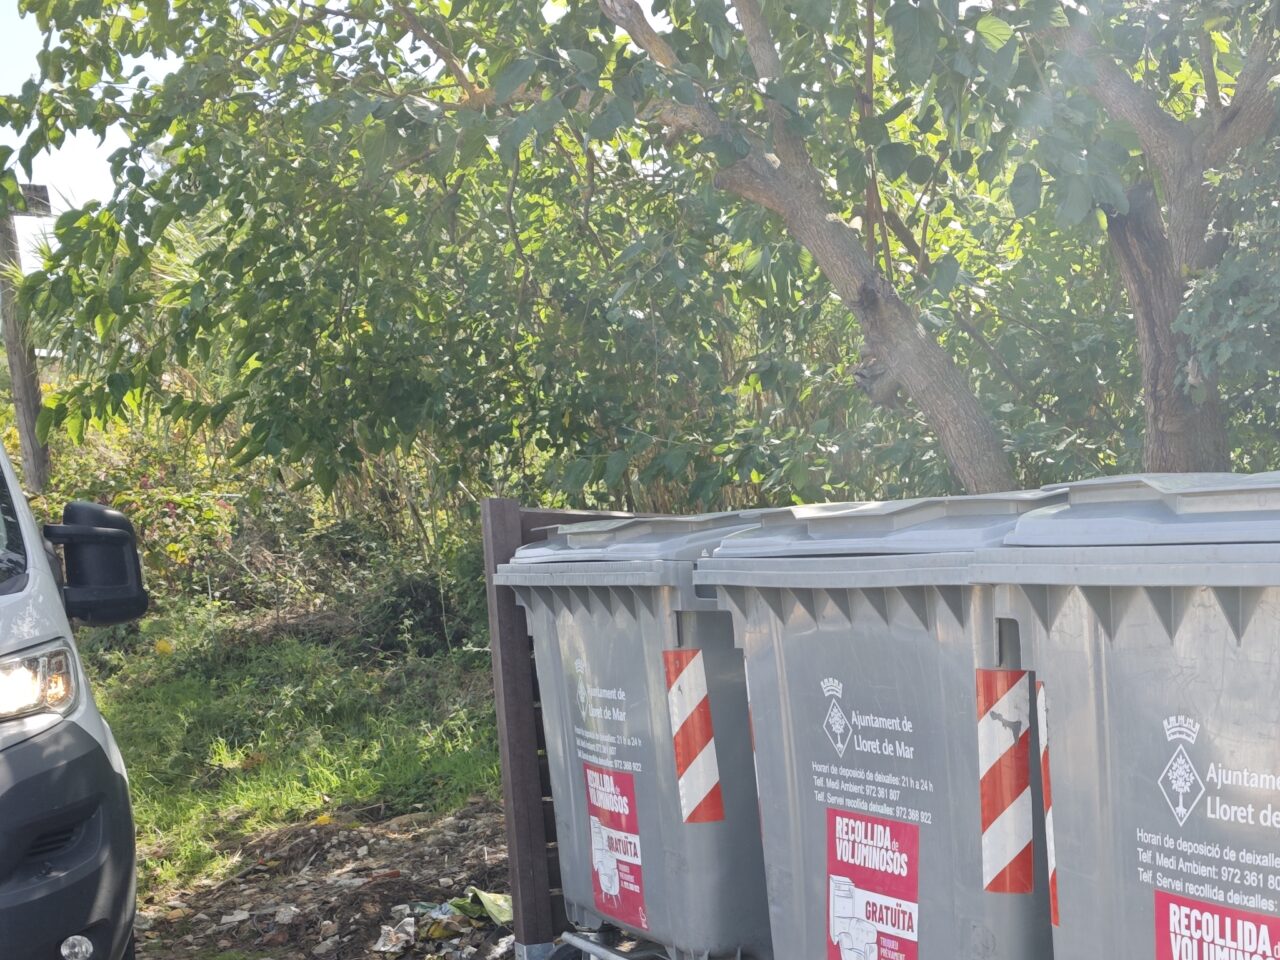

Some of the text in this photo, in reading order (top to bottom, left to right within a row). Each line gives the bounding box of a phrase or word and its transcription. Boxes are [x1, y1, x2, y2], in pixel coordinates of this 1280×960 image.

[851, 710, 913, 733] Ajuntament de
[854, 734, 915, 759] Lloret de Mar
[831, 764, 838, 775] de
[866, 769, 874, 781] de
[901, 775, 909, 788] 21
[920, 779, 929, 791] 24
[865, 784, 876, 797] 972
[895, 806, 907, 819] 972
[920, 811, 932, 824] 922
[1206, 796, 1255, 825] Lloret
[835, 815, 899, 851] RECOLLIDA de
[1136, 827, 1162, 846] Horari
[1163, 834, 1175, 849] de
[1176, 838, 1220, 858] deposició
[1223, 845, 1236, 862] de
[836, 837, 908, 877] VOLUMINOSOS
[1136, 847, 1155, 865] Telf.
[1155, 852, 1177, 870] Medi
[1177, 857, 1219, 879] Ambient:
[1221, 866, 1241, 884] 972
[1243, 871, 1264, 888] 361
[1138, 867, 1155, 885] Telf.
[1156, 871, 1184, 892] Servei
[1185, 881, 1225, 902] recollida
[1226, 890, 1278, 912] deixalles:
[865, 900, 914, 933] GRATUÏTA
[1168, 902, 1272, 957] RECOLLIDA
